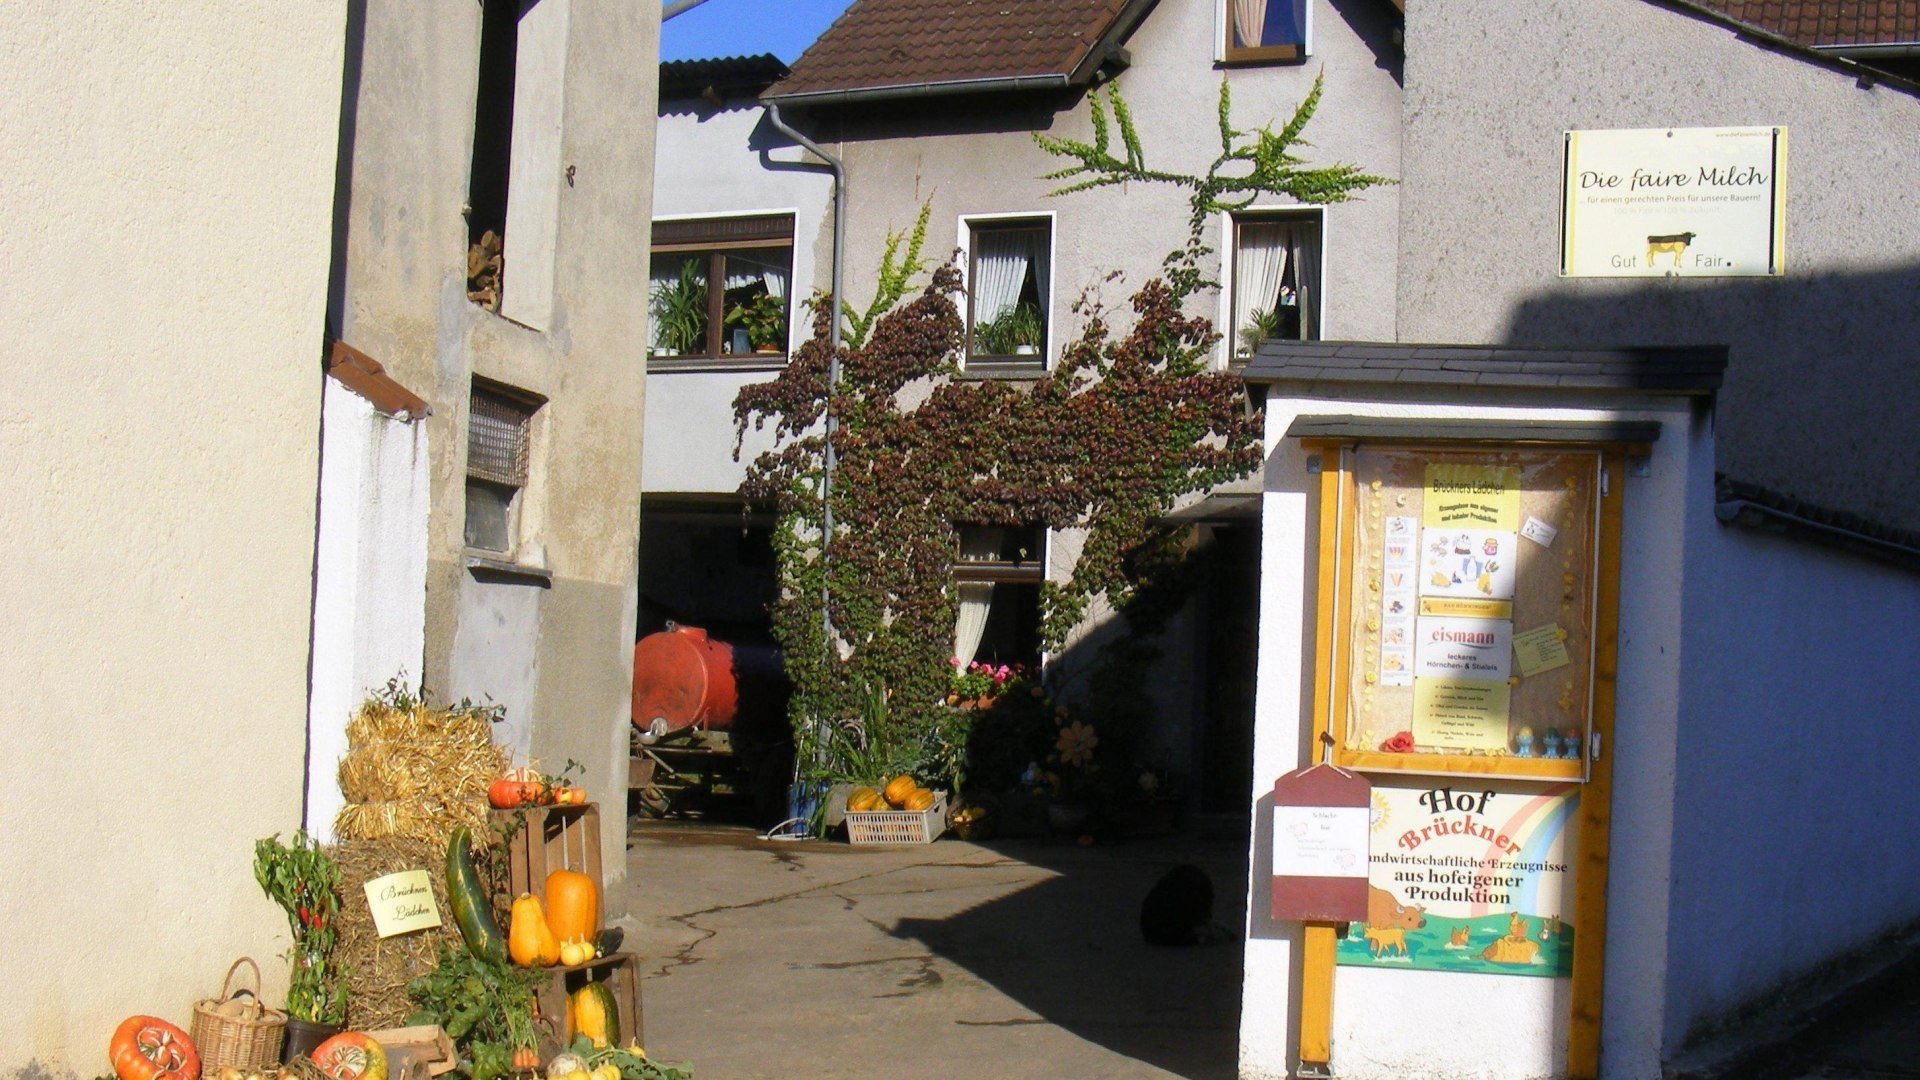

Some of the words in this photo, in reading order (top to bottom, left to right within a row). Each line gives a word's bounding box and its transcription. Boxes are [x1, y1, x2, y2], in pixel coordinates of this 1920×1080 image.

[1579, 170, 1623, 189] Die
[1630, 167, 1692, 192] faire
[1697, 165, 1769, 187] Milch
[1600, 196, 1622, 204] einen
[1624, 195, 1665, 205] gerechten
[1666, 194, 1686, 203] Preis
[1687, 194, 1699, 203] für
[1730, 193, 1761, 202] Bauern!
[1611, 254, 1636, 268] Gut
[1433, 479, 1471, 494] Brückners
[1472, 480, 1505, 495] Lädchen
[1432, 626, 1495, 645] eismann
[1447, 653, 1477, 661] leckeres
[1426, 661, 1464, 670] Hörnchen-
[1472, 663, 1498, 671] Stieleis
[1418, 787, 1496, 816] Hof
[1398, 815, 1521, 855] Brückner
[1487, 858, 1568, 873] Erzeugnisse
[1394, 870, 1424, 882] aus
[1428, 868, 1523, 890] hofeigener
[1405, 886, 1511, 905] Produktion
[393, 904, 430, 921] Lädchen
